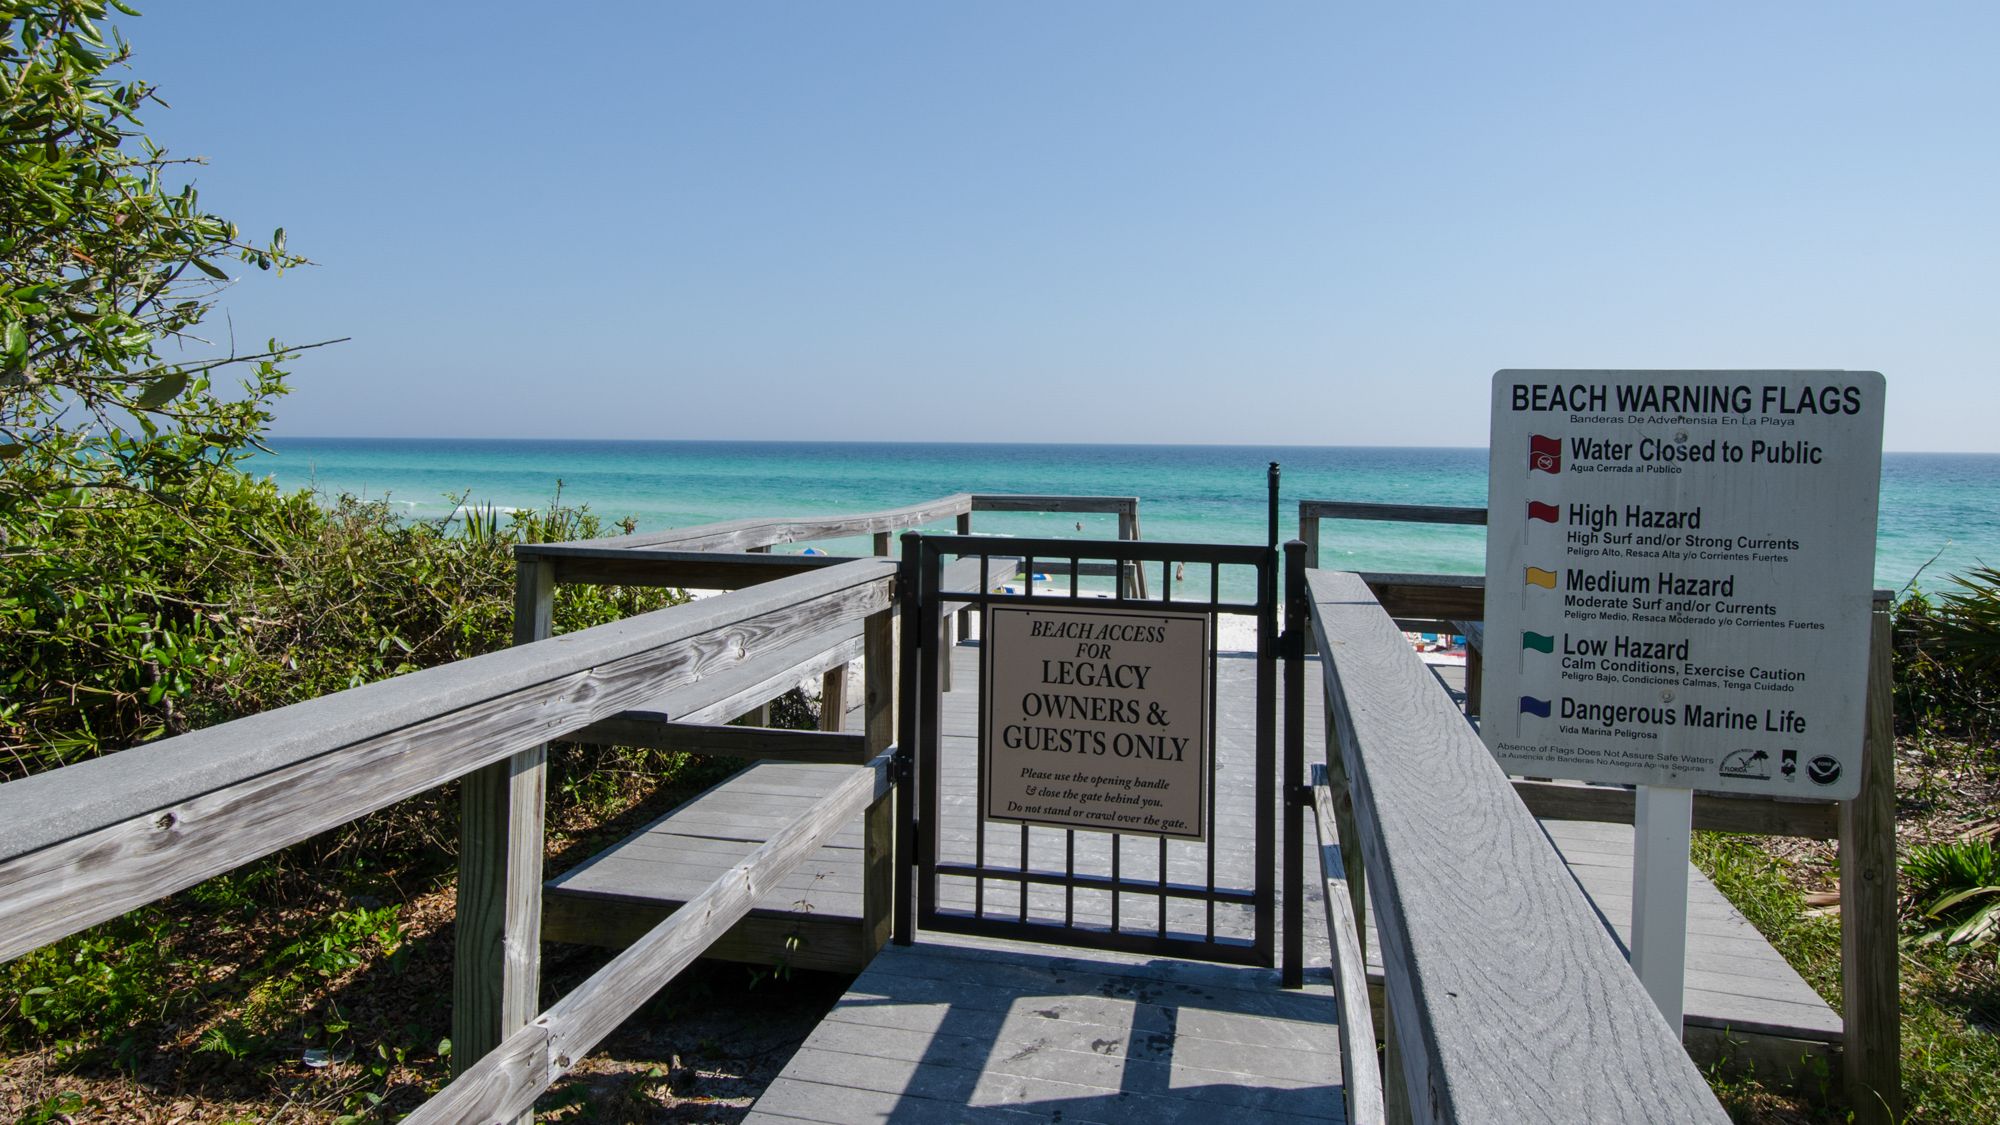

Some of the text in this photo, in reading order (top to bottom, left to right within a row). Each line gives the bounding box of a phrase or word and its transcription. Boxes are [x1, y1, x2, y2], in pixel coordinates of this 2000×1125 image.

[1512, 384, 1861, 415] BEACH WARNING FLAGS
[1570, 415, 1624, 424] Banderas
[1628, 415, 1645, 424] De
[1721, 416, 1738, 425] En
[1742, 416, 1757, 426] La
[1761, 417, 1795, 427] Playa
[1571, 437, 1823, 464] Water Closed to Public
[1570, 463, 1682, 474] Agua Cerrada al Publico
[1569, 503, 1701, 532] High Hazard
[1567, 531, 1800, 551] High Surf and/or Strong Currents
[1567, 547, 1789, 563] Peligro Alto, Resaca Alta y/o Corrientes Fuertes
[1566, 568, 1734, 597] Medium Hazard
[1565, 595, 1777, 616] Moderate Surf and/or Currents
[1030, 620, 1166, 643] BEACH ACCESS
[1564, 610, 1825, 630] Peligro Medio, Resaca Moderado y/o Corrientes Fuertes
[1075, 643, 1112, 660] FOR
[1563, 633, 1689, 661] Low Hazard
[1041, 660, 1151, 689] LEGACY
[1561, 656, 1805, 681] Calm Conditions, Exercise Caution
[1561, 671, 1594, 682] Peligro
[1622, 674, 1680, 686] Condiciones
[1723, 680, 1752, 691] Tenga
[1754, 682, 1794, 692] Cuidado
[1022, 692, 1171, 726] OWNERS &
[1561, 697, 1806, 734] Dangerous Marine Life
[1003, 725, 1190, 762] GUESTS ONLY
[1560, 725, 1658, 740] Vida Marina Peligrosa
[1497, 742, 1714, 764] Absence of Flags Does Not Assure Safe Waters
[1020, 767, 1170, 790] Please use the opening handle
[1025, 784, 1163, 809] & close the gate behind you.
[1007, 800, 1188, 831] Do not stand or crawl over the gate.
